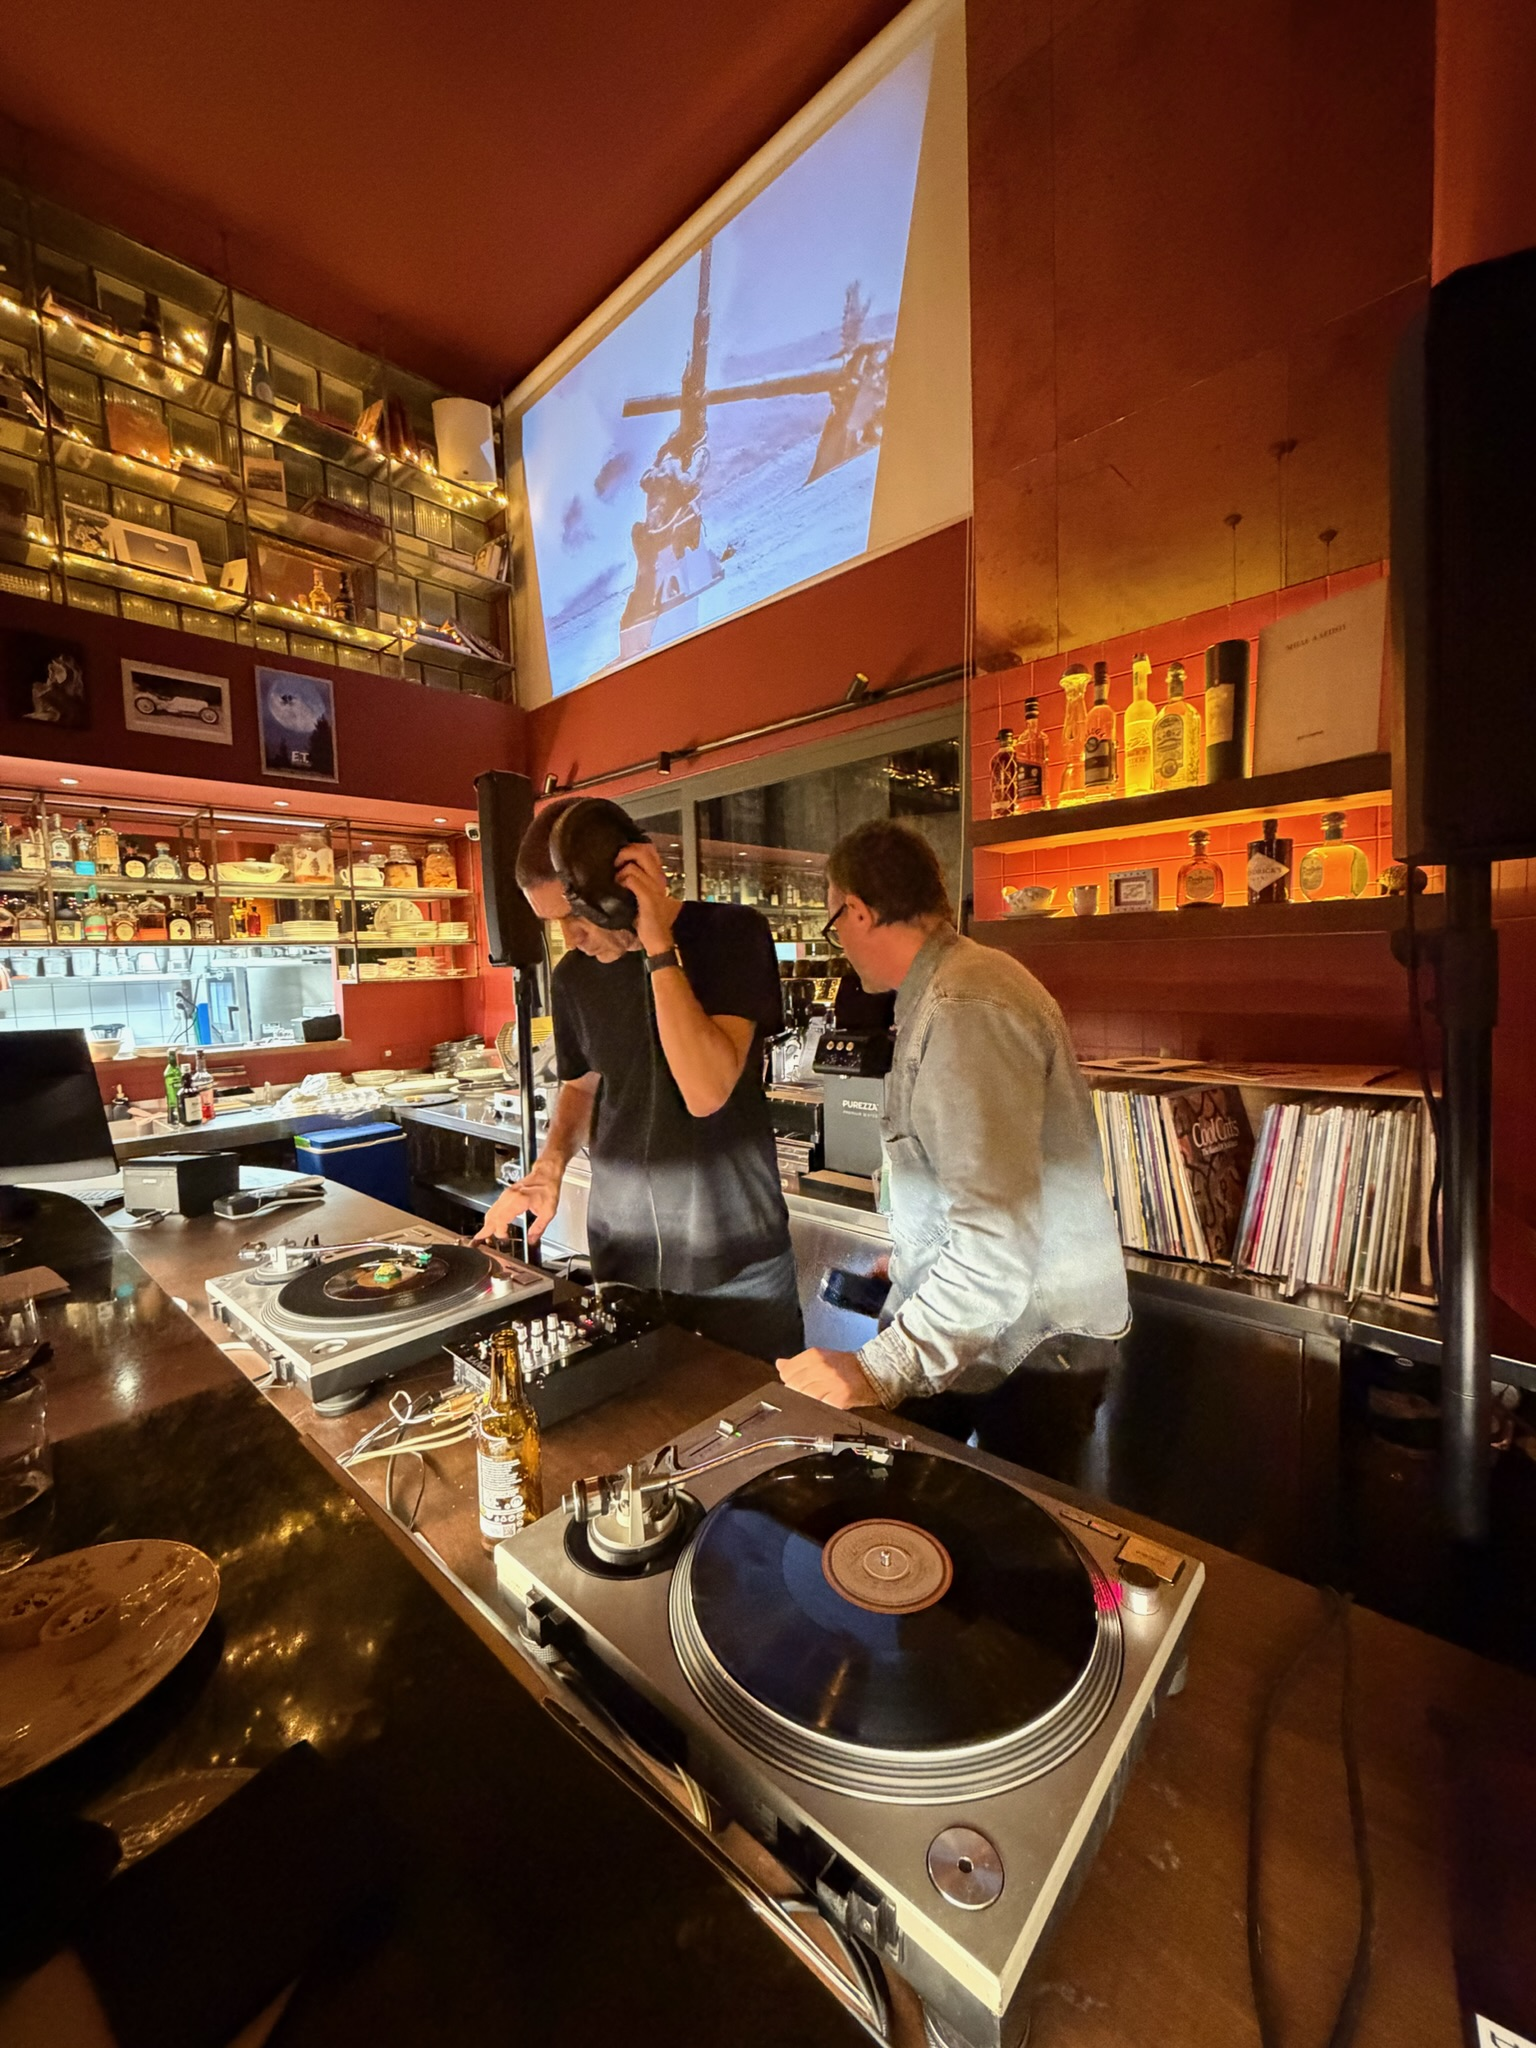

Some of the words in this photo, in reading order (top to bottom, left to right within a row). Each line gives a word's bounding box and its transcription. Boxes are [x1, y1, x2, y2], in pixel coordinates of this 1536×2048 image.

[291, 750, 310, 764] E.T.
[842, 1099, 878, 1112] PUREZZA
[1192, 1117, 1218, 1148] Cool
